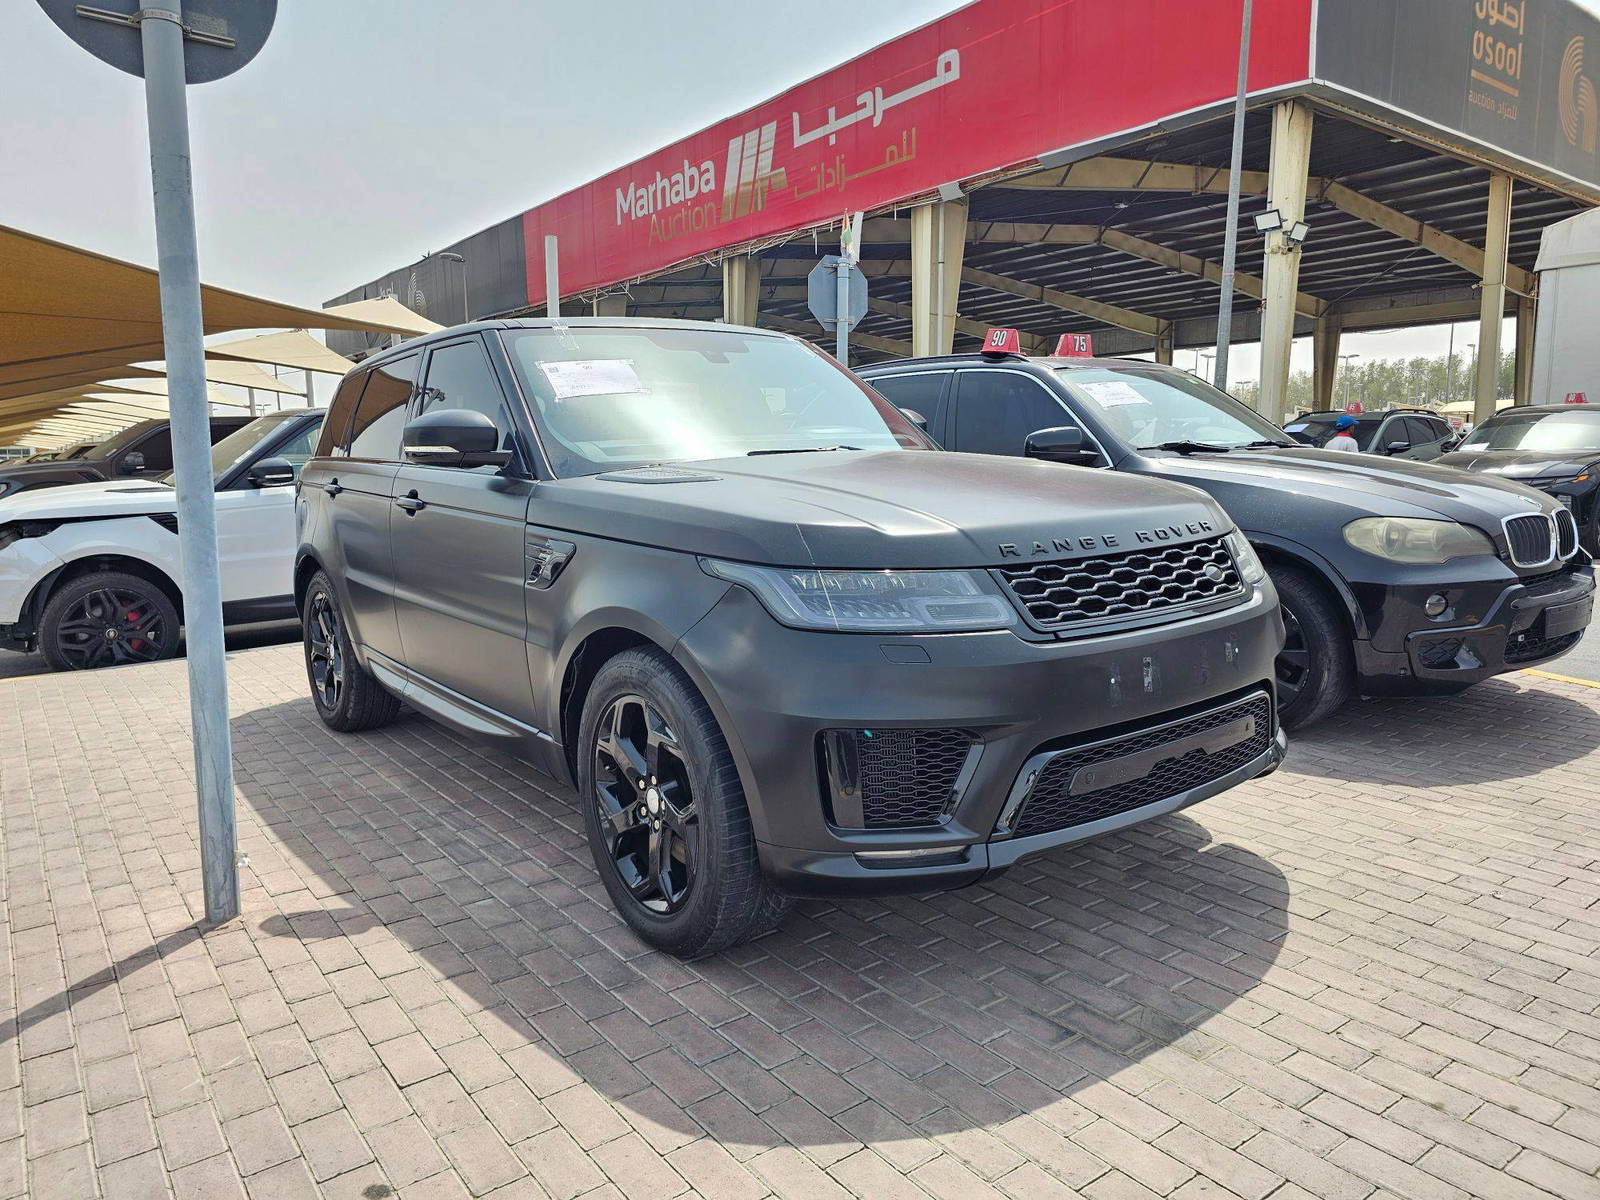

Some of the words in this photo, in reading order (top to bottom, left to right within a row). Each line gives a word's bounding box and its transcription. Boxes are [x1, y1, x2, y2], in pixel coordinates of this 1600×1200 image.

[793, 48, 960, 148] مرحبا
[795, 127, 916, 198] للمزادات
[616, 159, 716, 226] Marhaba
[648, 201, 716, 248] Auction
[991, 330, 1007, 346] 90
[1073, 335, 1087, 352] 75
[998, 534, 1119, 558] RANGE
[1135, 520, 1213, 543] ROVER
